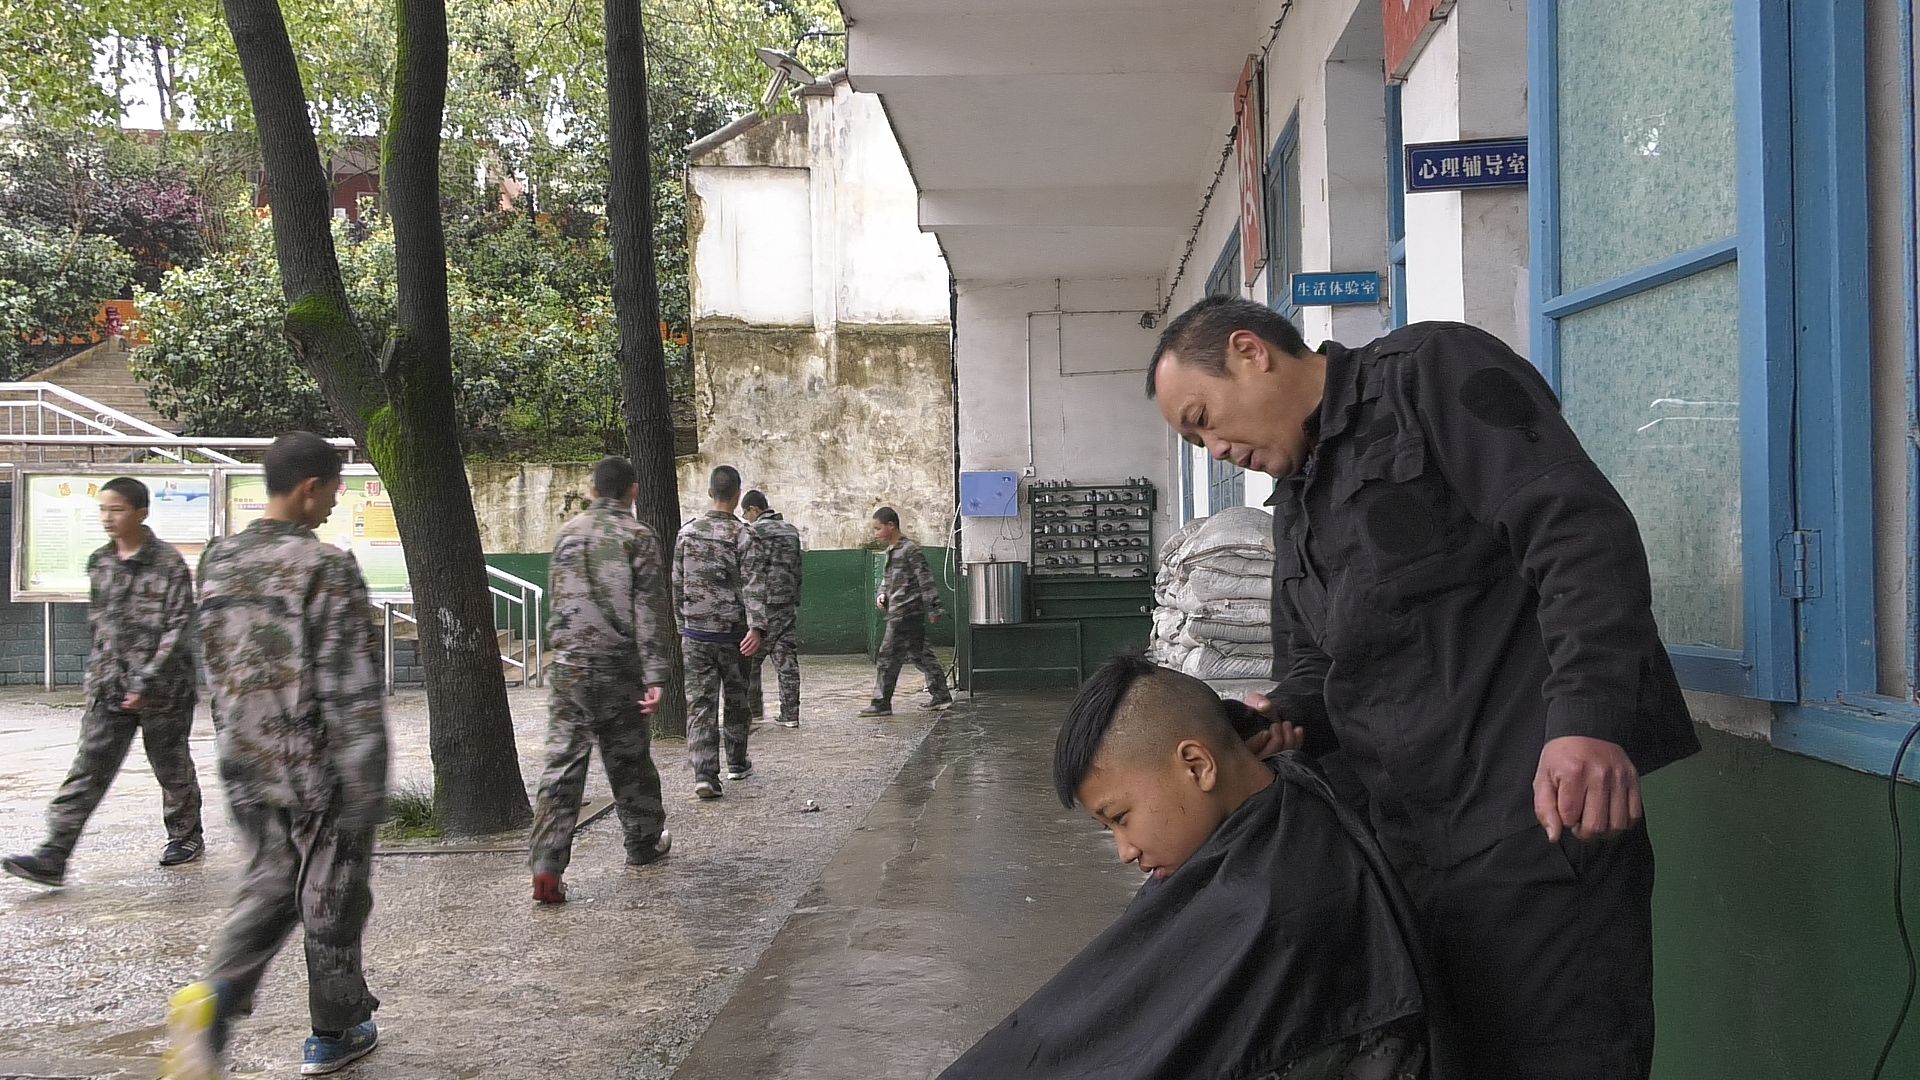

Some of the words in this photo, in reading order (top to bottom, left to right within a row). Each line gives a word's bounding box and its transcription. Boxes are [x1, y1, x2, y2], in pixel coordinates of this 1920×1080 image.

[1418, 152, 1526, 180] 心理辅导室
[1297, 280, 1376, 297] 生活体验室
